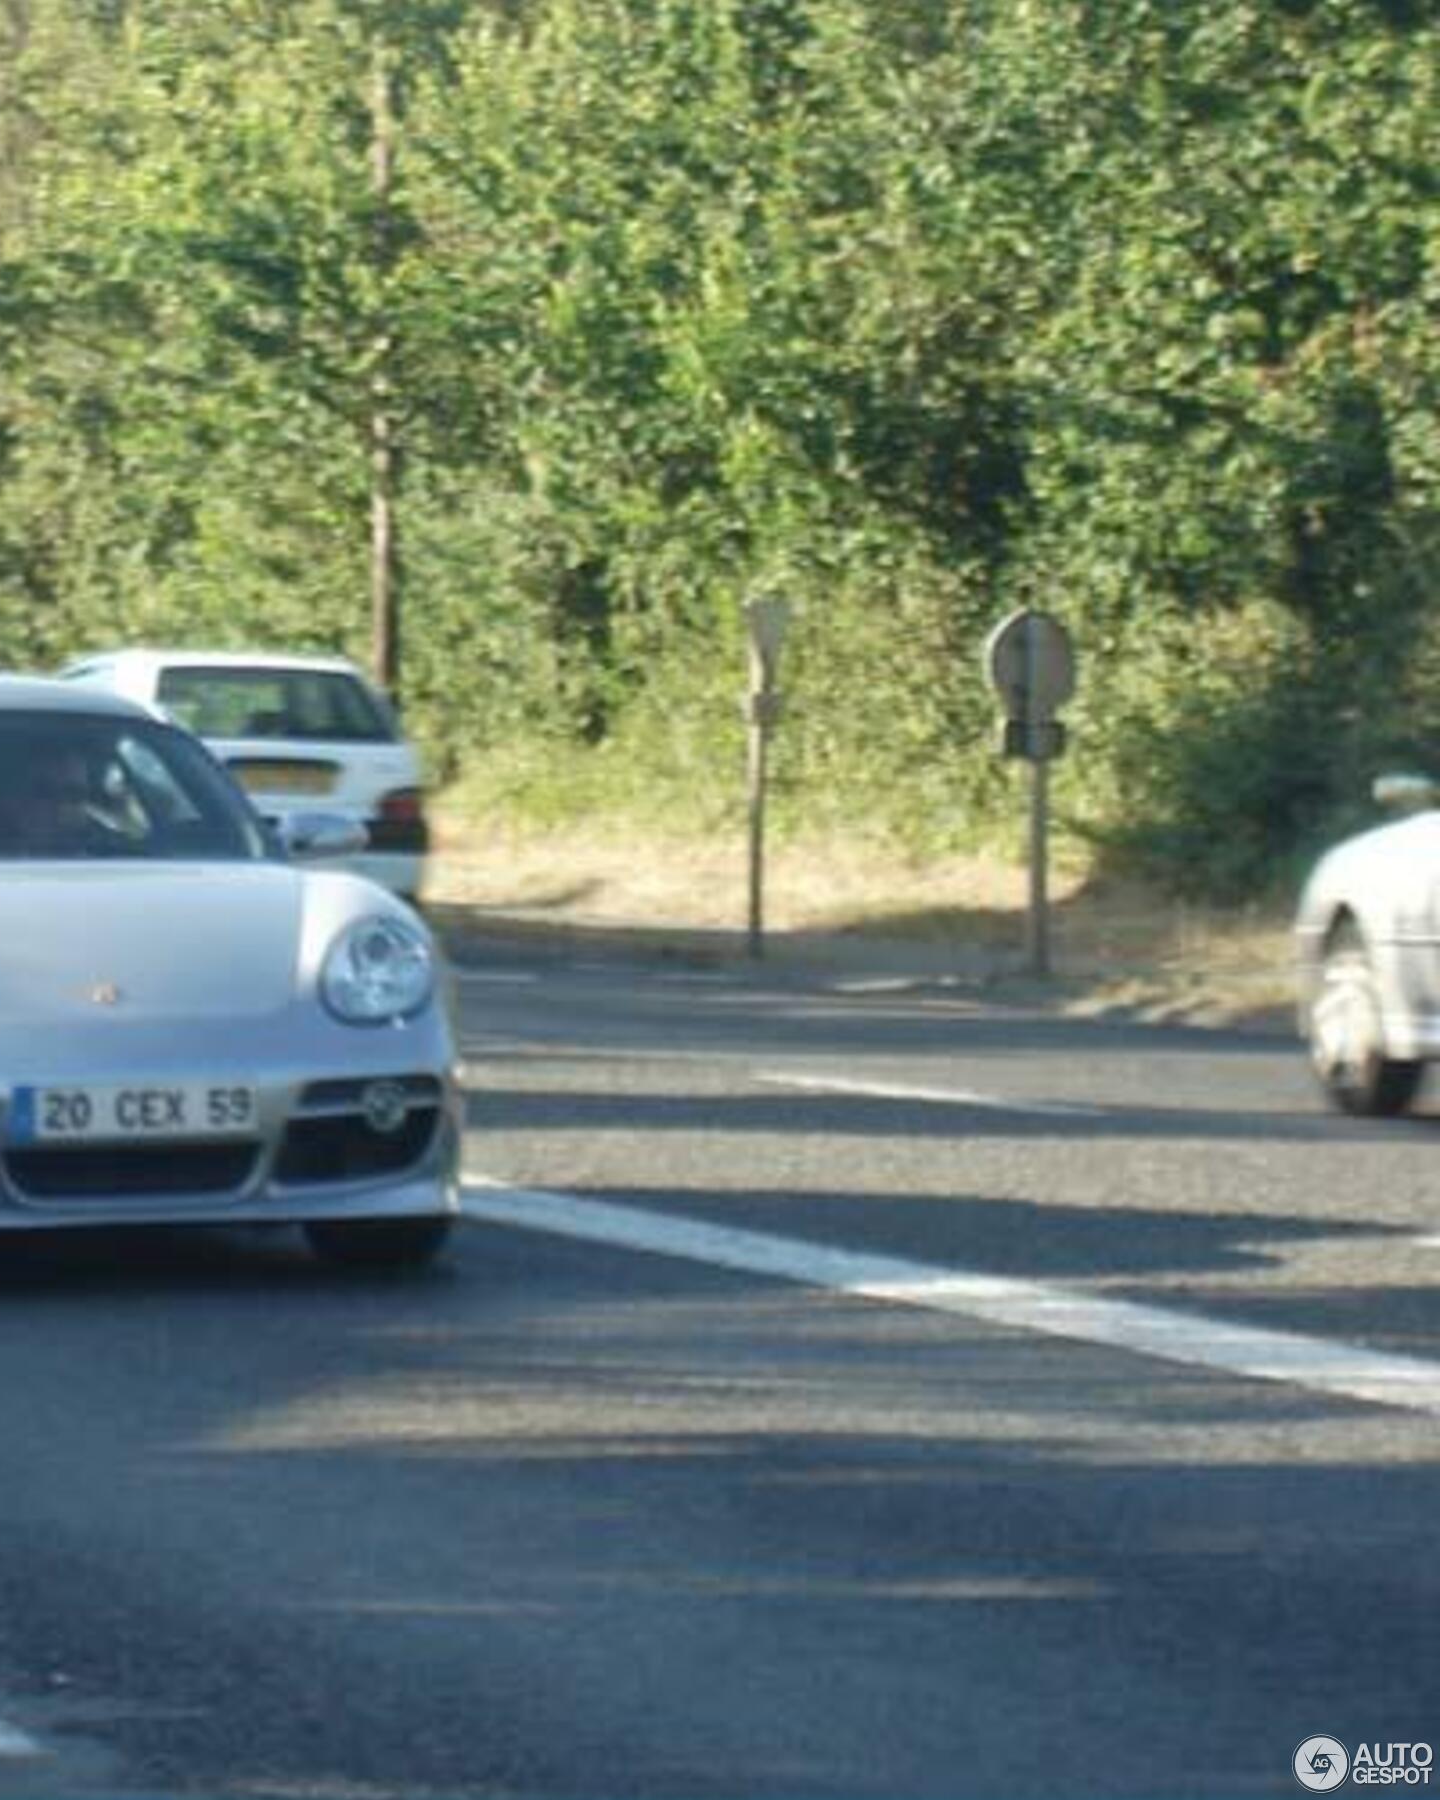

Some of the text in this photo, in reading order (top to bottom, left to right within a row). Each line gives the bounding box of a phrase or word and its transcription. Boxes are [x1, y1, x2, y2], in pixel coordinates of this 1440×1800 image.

[44, 1087, 252, 1131] 20 CEX 59
